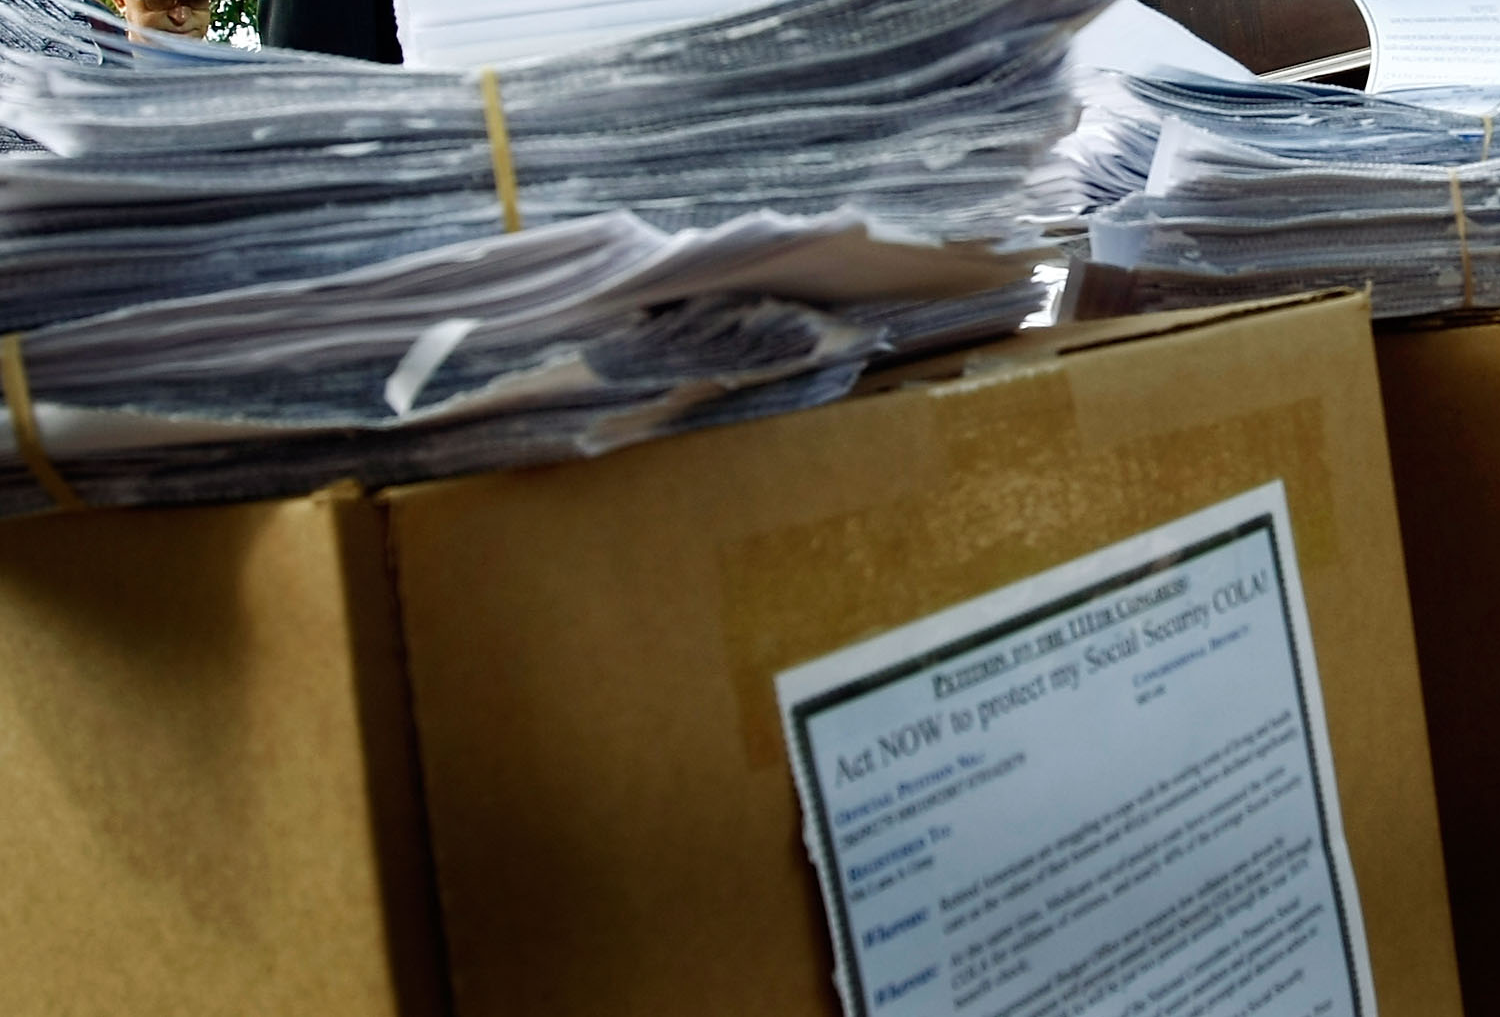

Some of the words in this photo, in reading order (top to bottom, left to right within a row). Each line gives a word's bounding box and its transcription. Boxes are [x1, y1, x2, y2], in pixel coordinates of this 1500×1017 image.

[835, 747, 876, 790] Act
[877, 709, 945, 769] NOW
[949, 707, 975, 735] to
[976, 673, 1047, 734] protect
[1049, 661, 1082, 694] my
[1084, 625, 1141, 675] Social
[1141, 603, 1211, 650] Security
